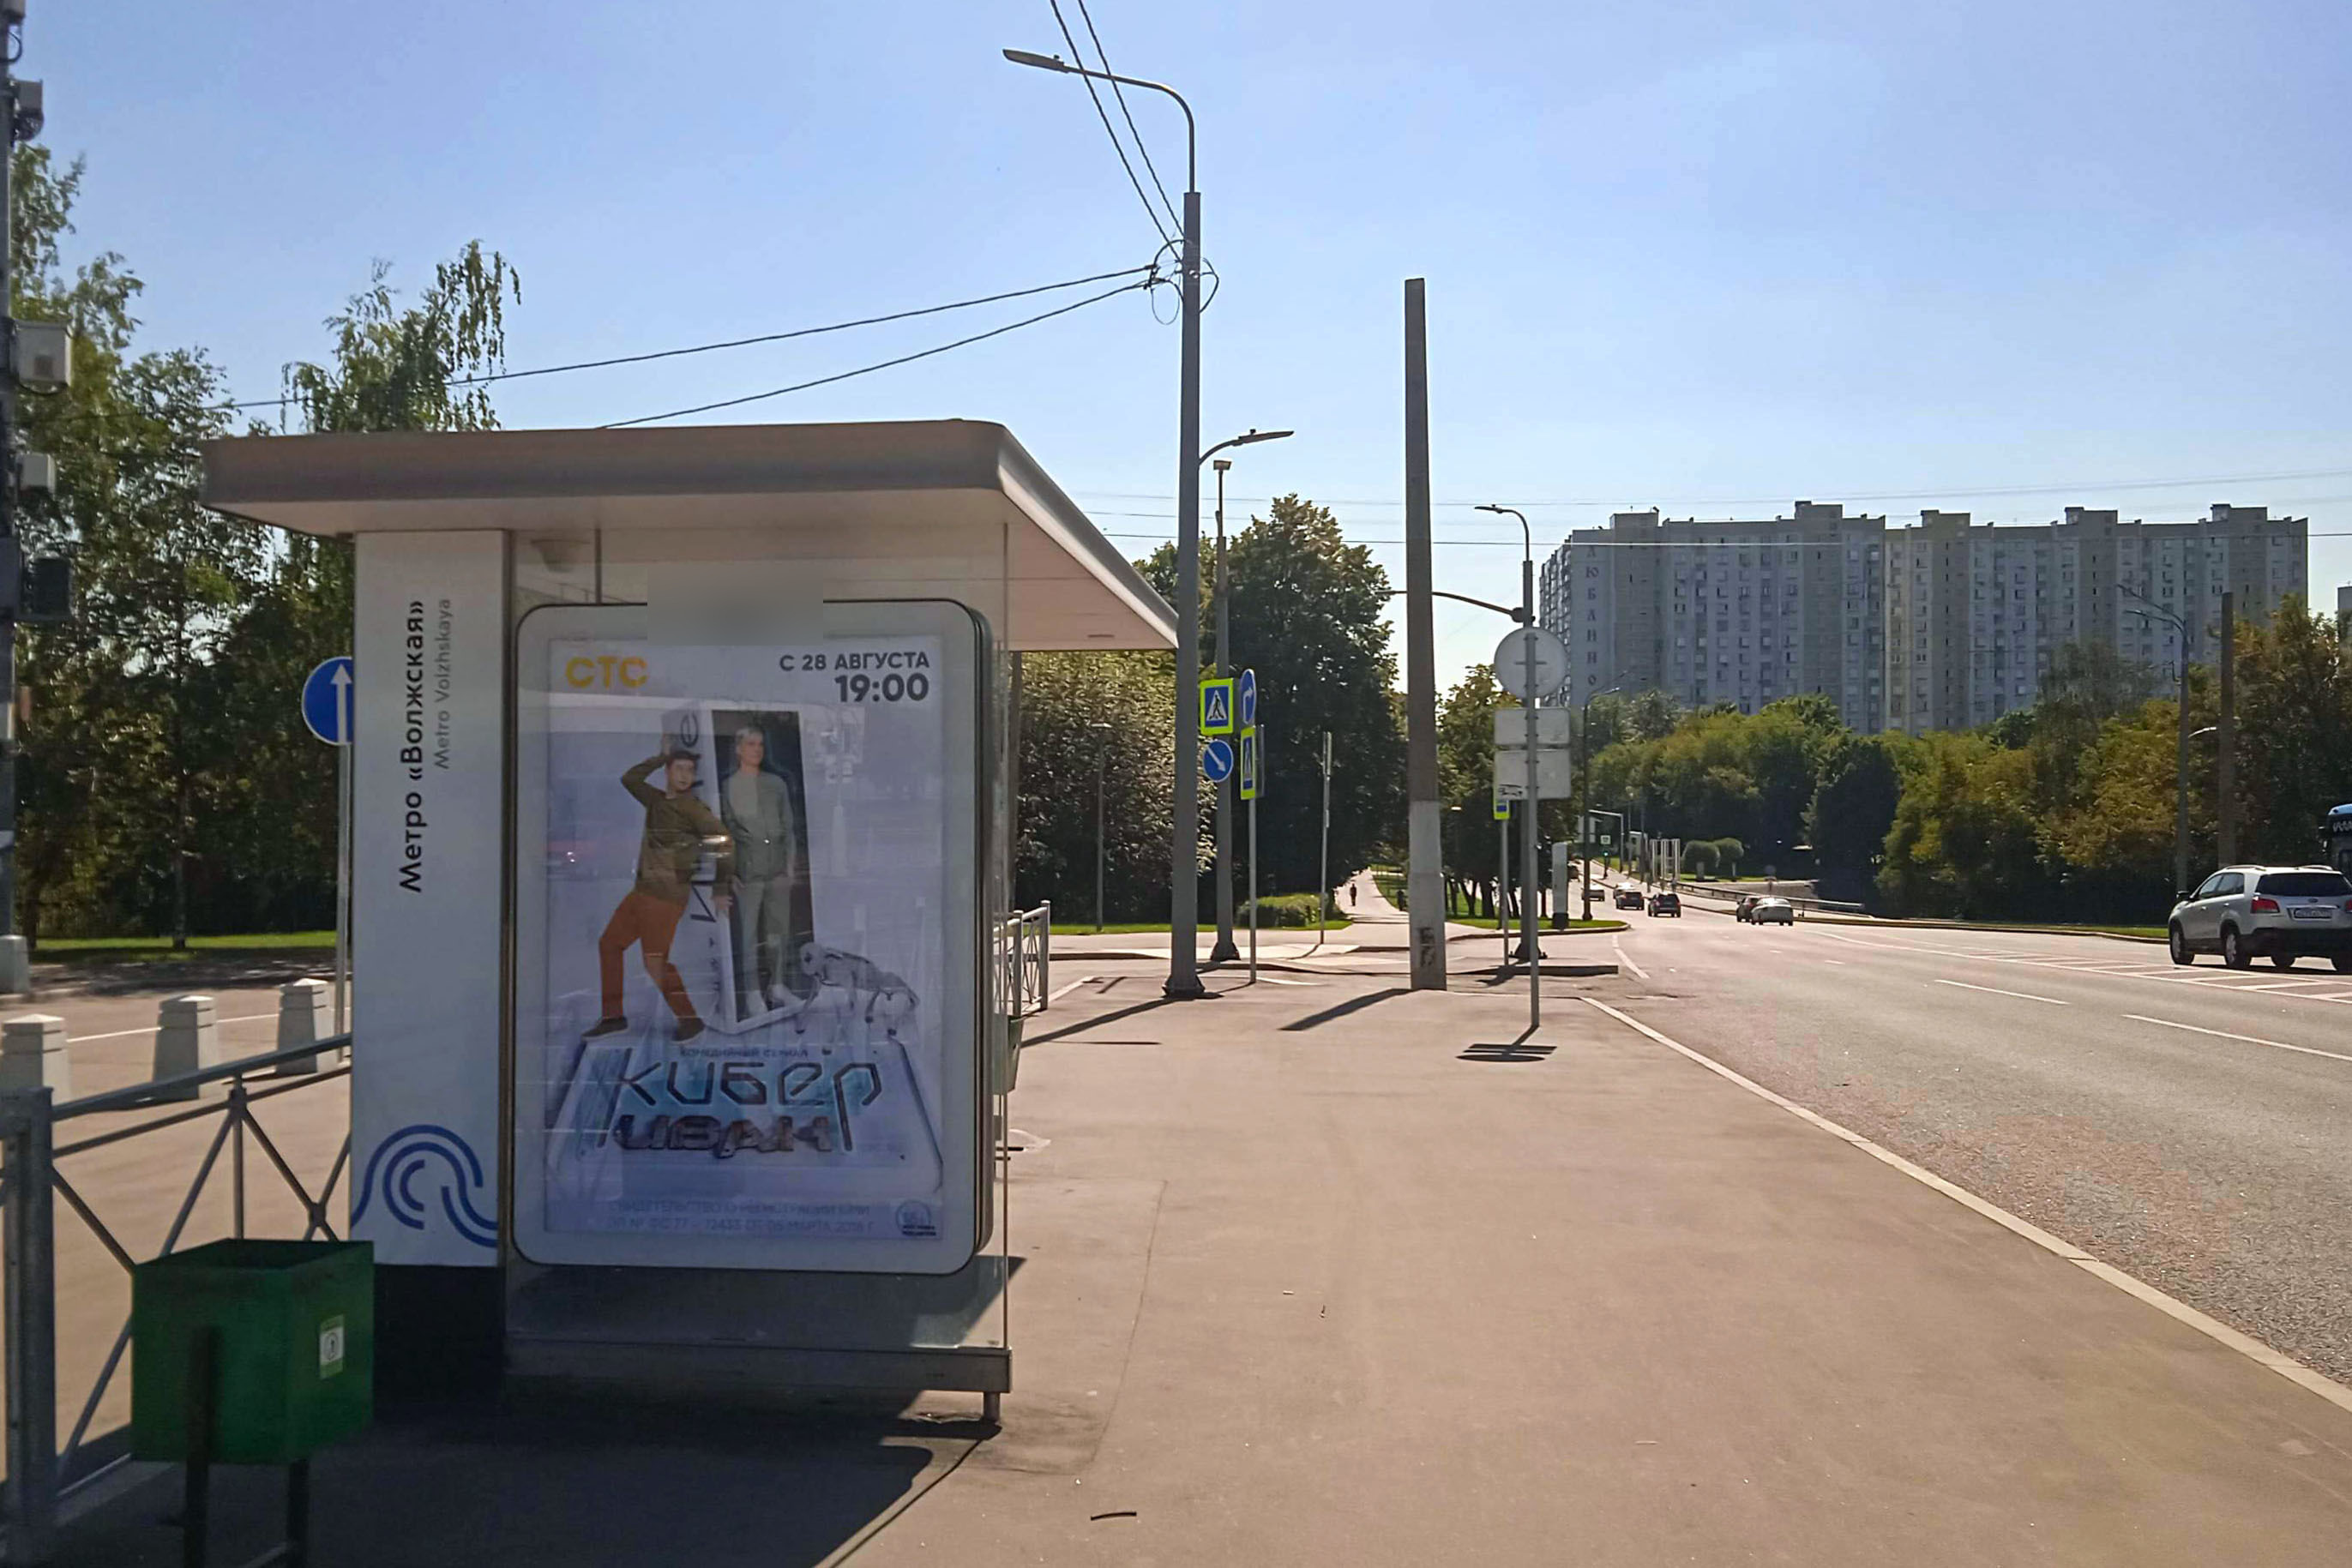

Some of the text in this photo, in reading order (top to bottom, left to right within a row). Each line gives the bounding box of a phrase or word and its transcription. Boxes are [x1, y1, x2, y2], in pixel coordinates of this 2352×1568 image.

[566, 655, 648, 688] СТС
[779, 652, 929, 671] С 28 АВГУСТА
[434, 599, 453, 769] Metro Volzhskaya
[834, 672, 929, 703] 19:00
[399, 601, 428, 893] Метро «Волжская»
